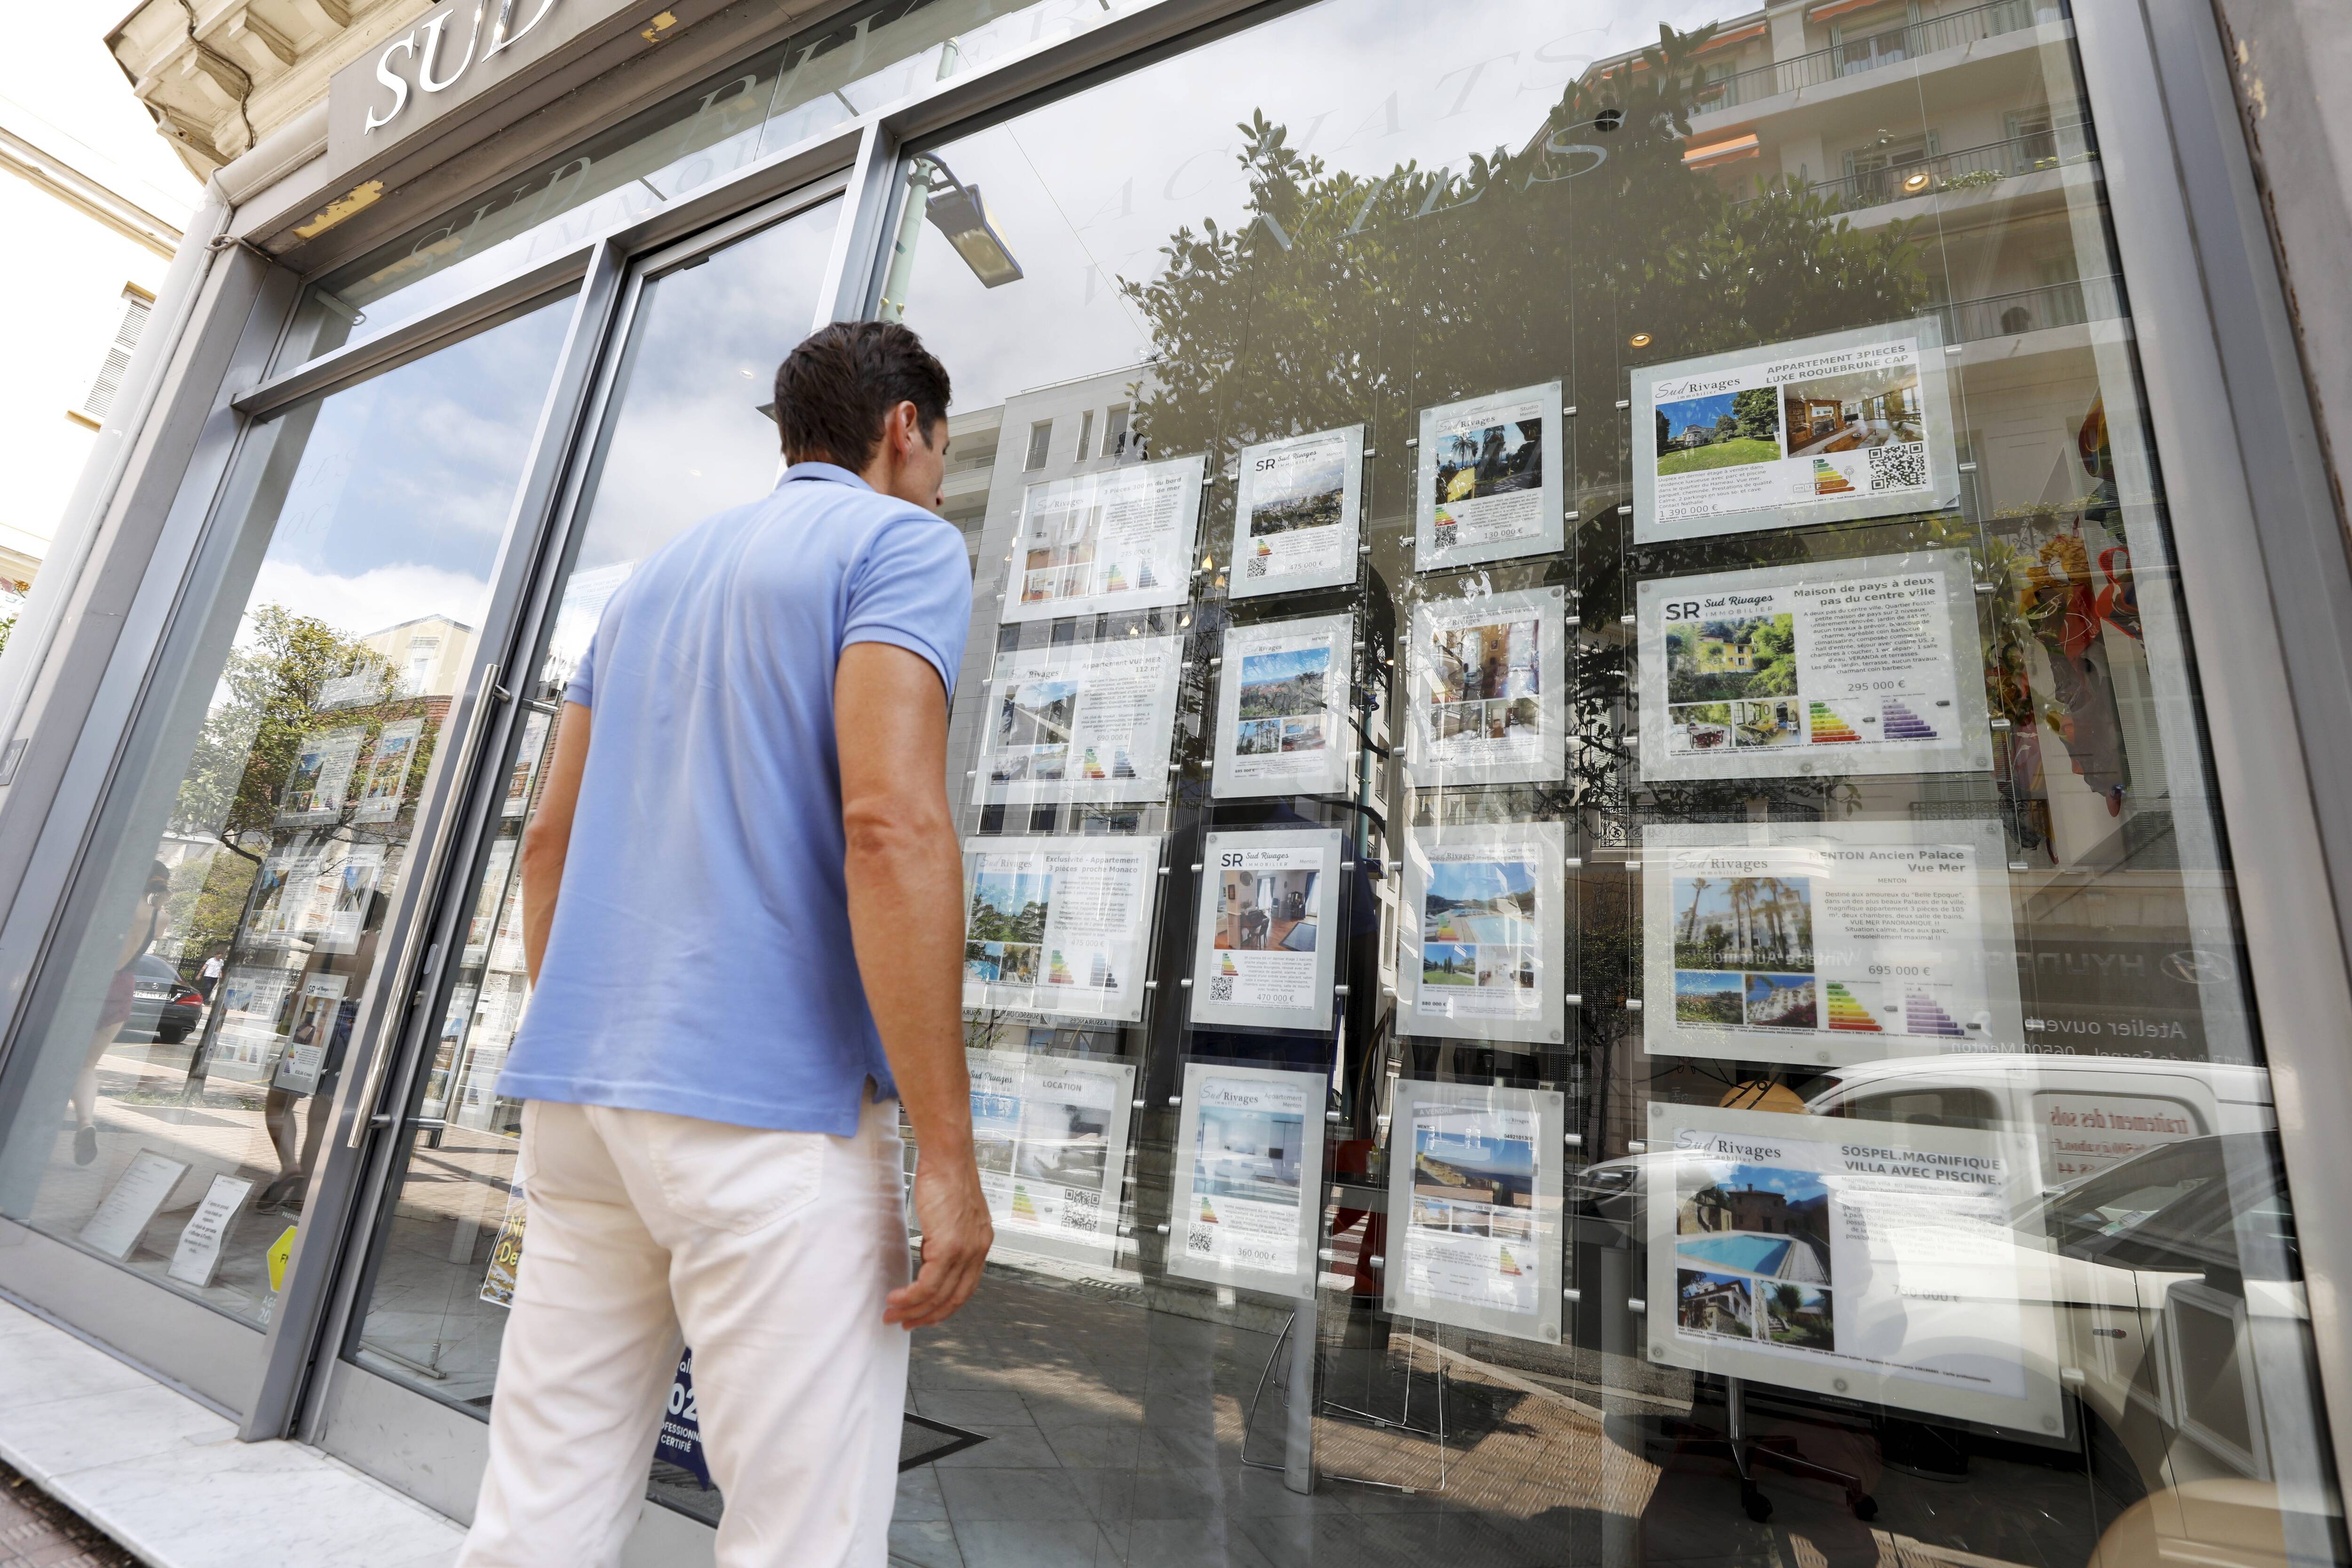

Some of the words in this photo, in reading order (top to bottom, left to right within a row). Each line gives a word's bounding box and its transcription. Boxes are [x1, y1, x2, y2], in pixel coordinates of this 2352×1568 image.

[364, 0, 555, 136] SUD
[1767, 353, 1854, 374] APPARTEMENT
[1856, 344, 1906, 359] 3PIECES
[1766, 373, 1795, 383] LUXE
[1799, 359, 1880, 378] ROQUEBRUNE
[1884, 354, 1908, 365] CAP
[1654, 380, 1689, 398] Sud
[1690, 378, 1740, 392] Rivages
[1677, 390, 1716, 399] immobilier
[1461, 415, 1495, 427] Rivages
[1255, 457, 1275, 472] SR
[1165, 477, 1181, 485] bord
[1054, 498, 1084, 507] Rivages
[1669, 508, 1686, 517] 390
[1690, 505, 1708, 514] 000
[1794, 586, 1835, 597] Maison
[1839, 584, 1855, 593] de
[1858, 582, 1888, 592] pays
[1903, 577, 1934, 586] deux
[1704, 597, 1725, 608] Sud
[1728, 594, 1774, 605] Rivages
[1820, 597, 1839, 606] pas
[1843, 594, 1860, 603] du
[1864, 591, 1905, 601] centre
[1665, 601, 1700, 621] SR
[1705, 606, 1772, 616] IMMOBILIER
[1028, 670, 1059, 679] Rivages
[1847, 682, 1869, 691] 295
[1872, 681, 1894, 690] 000
[1898, 680, 1905, 689] €
[1221, 853, 1243, 867] SR
[1261, 852, 1289, 860] Rivages
[1001, 860, 1032, 869] Rivages
[1711, 859, 1768, 871] Rivages
[1868, 966, 1892, 975] 695
[1896, 966, 1919, 975] 000
[1923, 967, 1930, 976] €
[307, 985, 316, 994] SR
[1042, 1080, 1081, 1091] LOCATION
[1200, 1084, 1224, 1100] Sud
[1224, 1092, 1258, 1105] Rivages
[1264, 1093, 1302, 1102] Appartement
[1426, 1106, 1453, 1117] VENDRE
[1676, 1129, 1717, 1154] Sud
[1718, 1141, 1781, 1161] Rivages
[1841, 1144, 2001, 1172] SOSPEL.MAGNIFIQUE
[1845, 1159, 1886, 1174] VILLA
[1890, 1164, 1931, 1178] AVEC
[1935, 1169, 2002, 1186] PISCINE.
[1237, 1248, 1253, 1257] 360
[1255, 1250, 1270, 1260] 000
[660, 1434, 691, 1452] CERTIFIÉ
